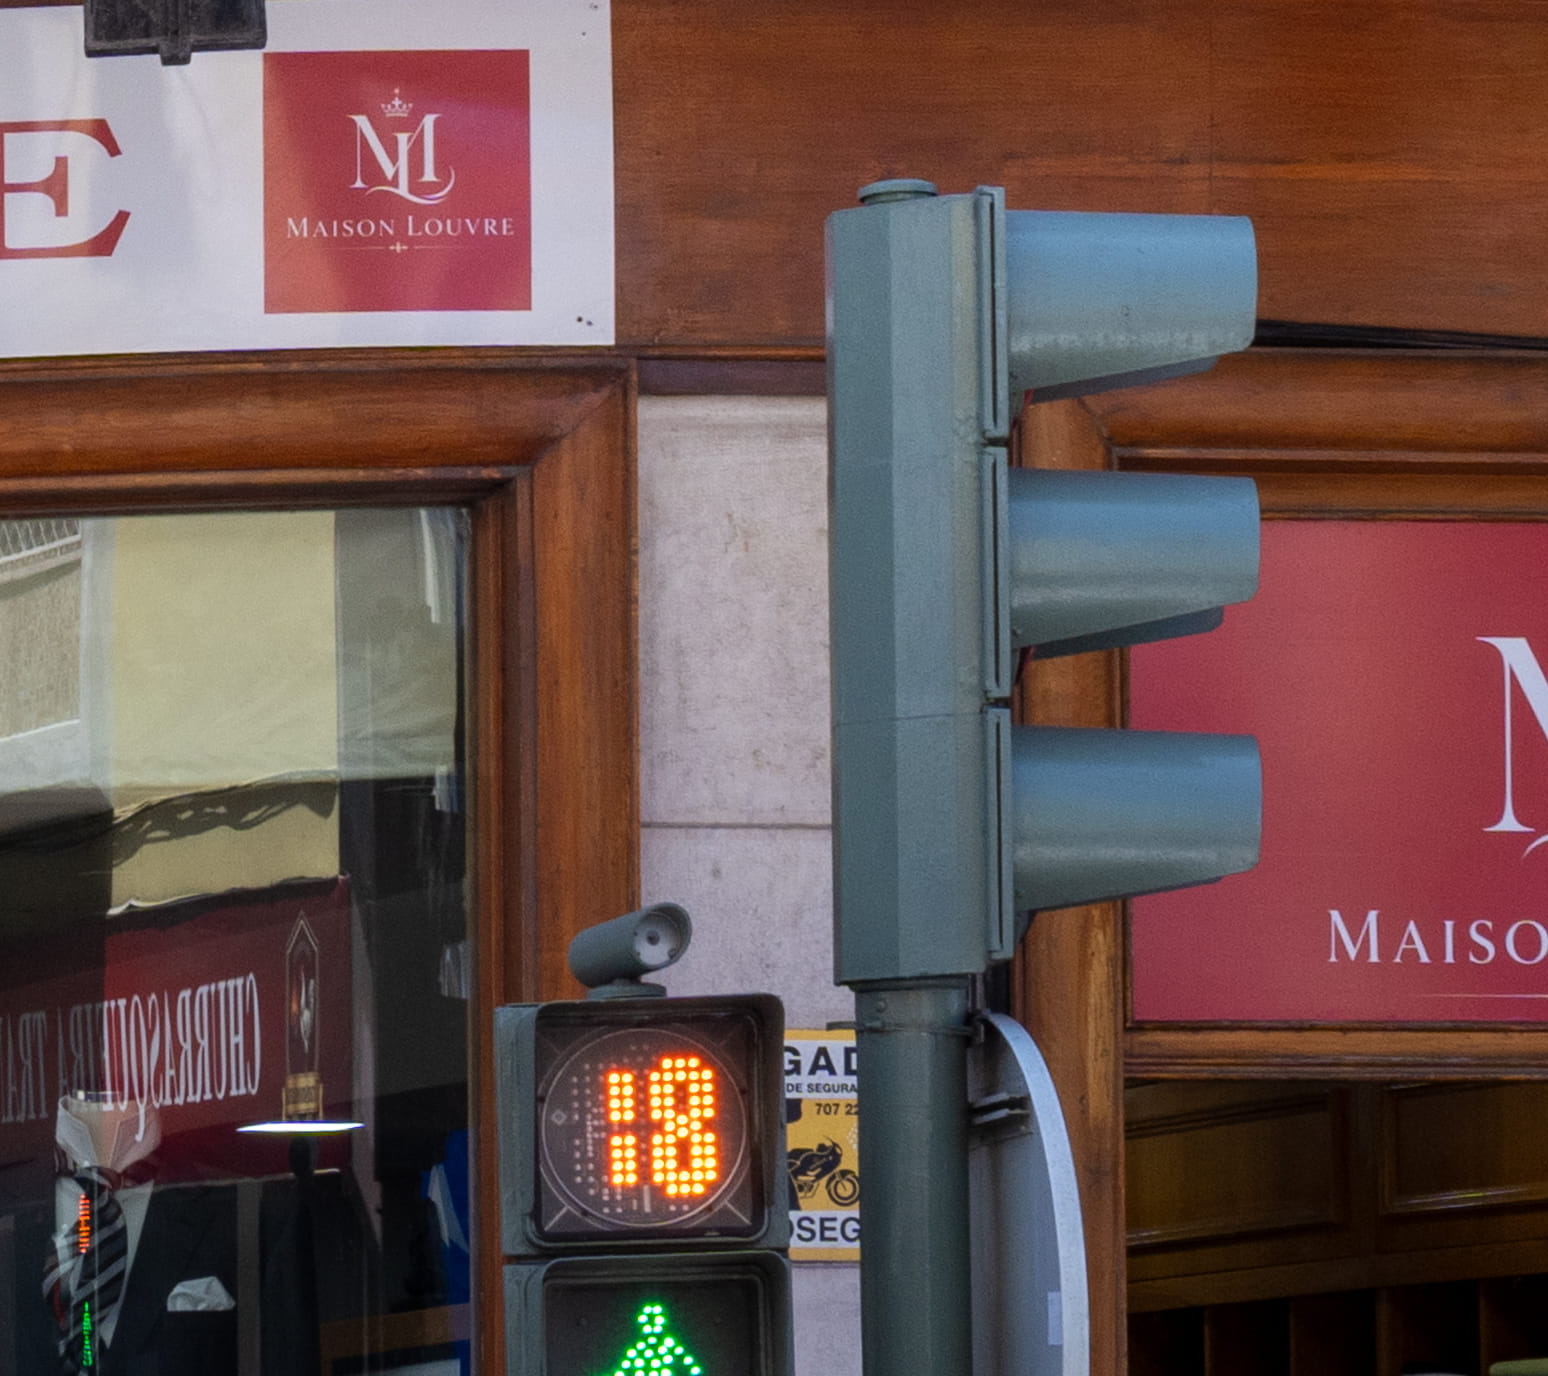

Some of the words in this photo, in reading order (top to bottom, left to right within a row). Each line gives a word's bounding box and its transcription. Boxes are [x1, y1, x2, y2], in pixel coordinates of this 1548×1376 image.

[286, 216, 395, 239] MAISON
[407, 214, 516, 238] LOUVRE
[785, 1082, 803, 1094] DE
[815, 1102, 840, 1116] 707
[606, 1054, 719, 1197] 18
